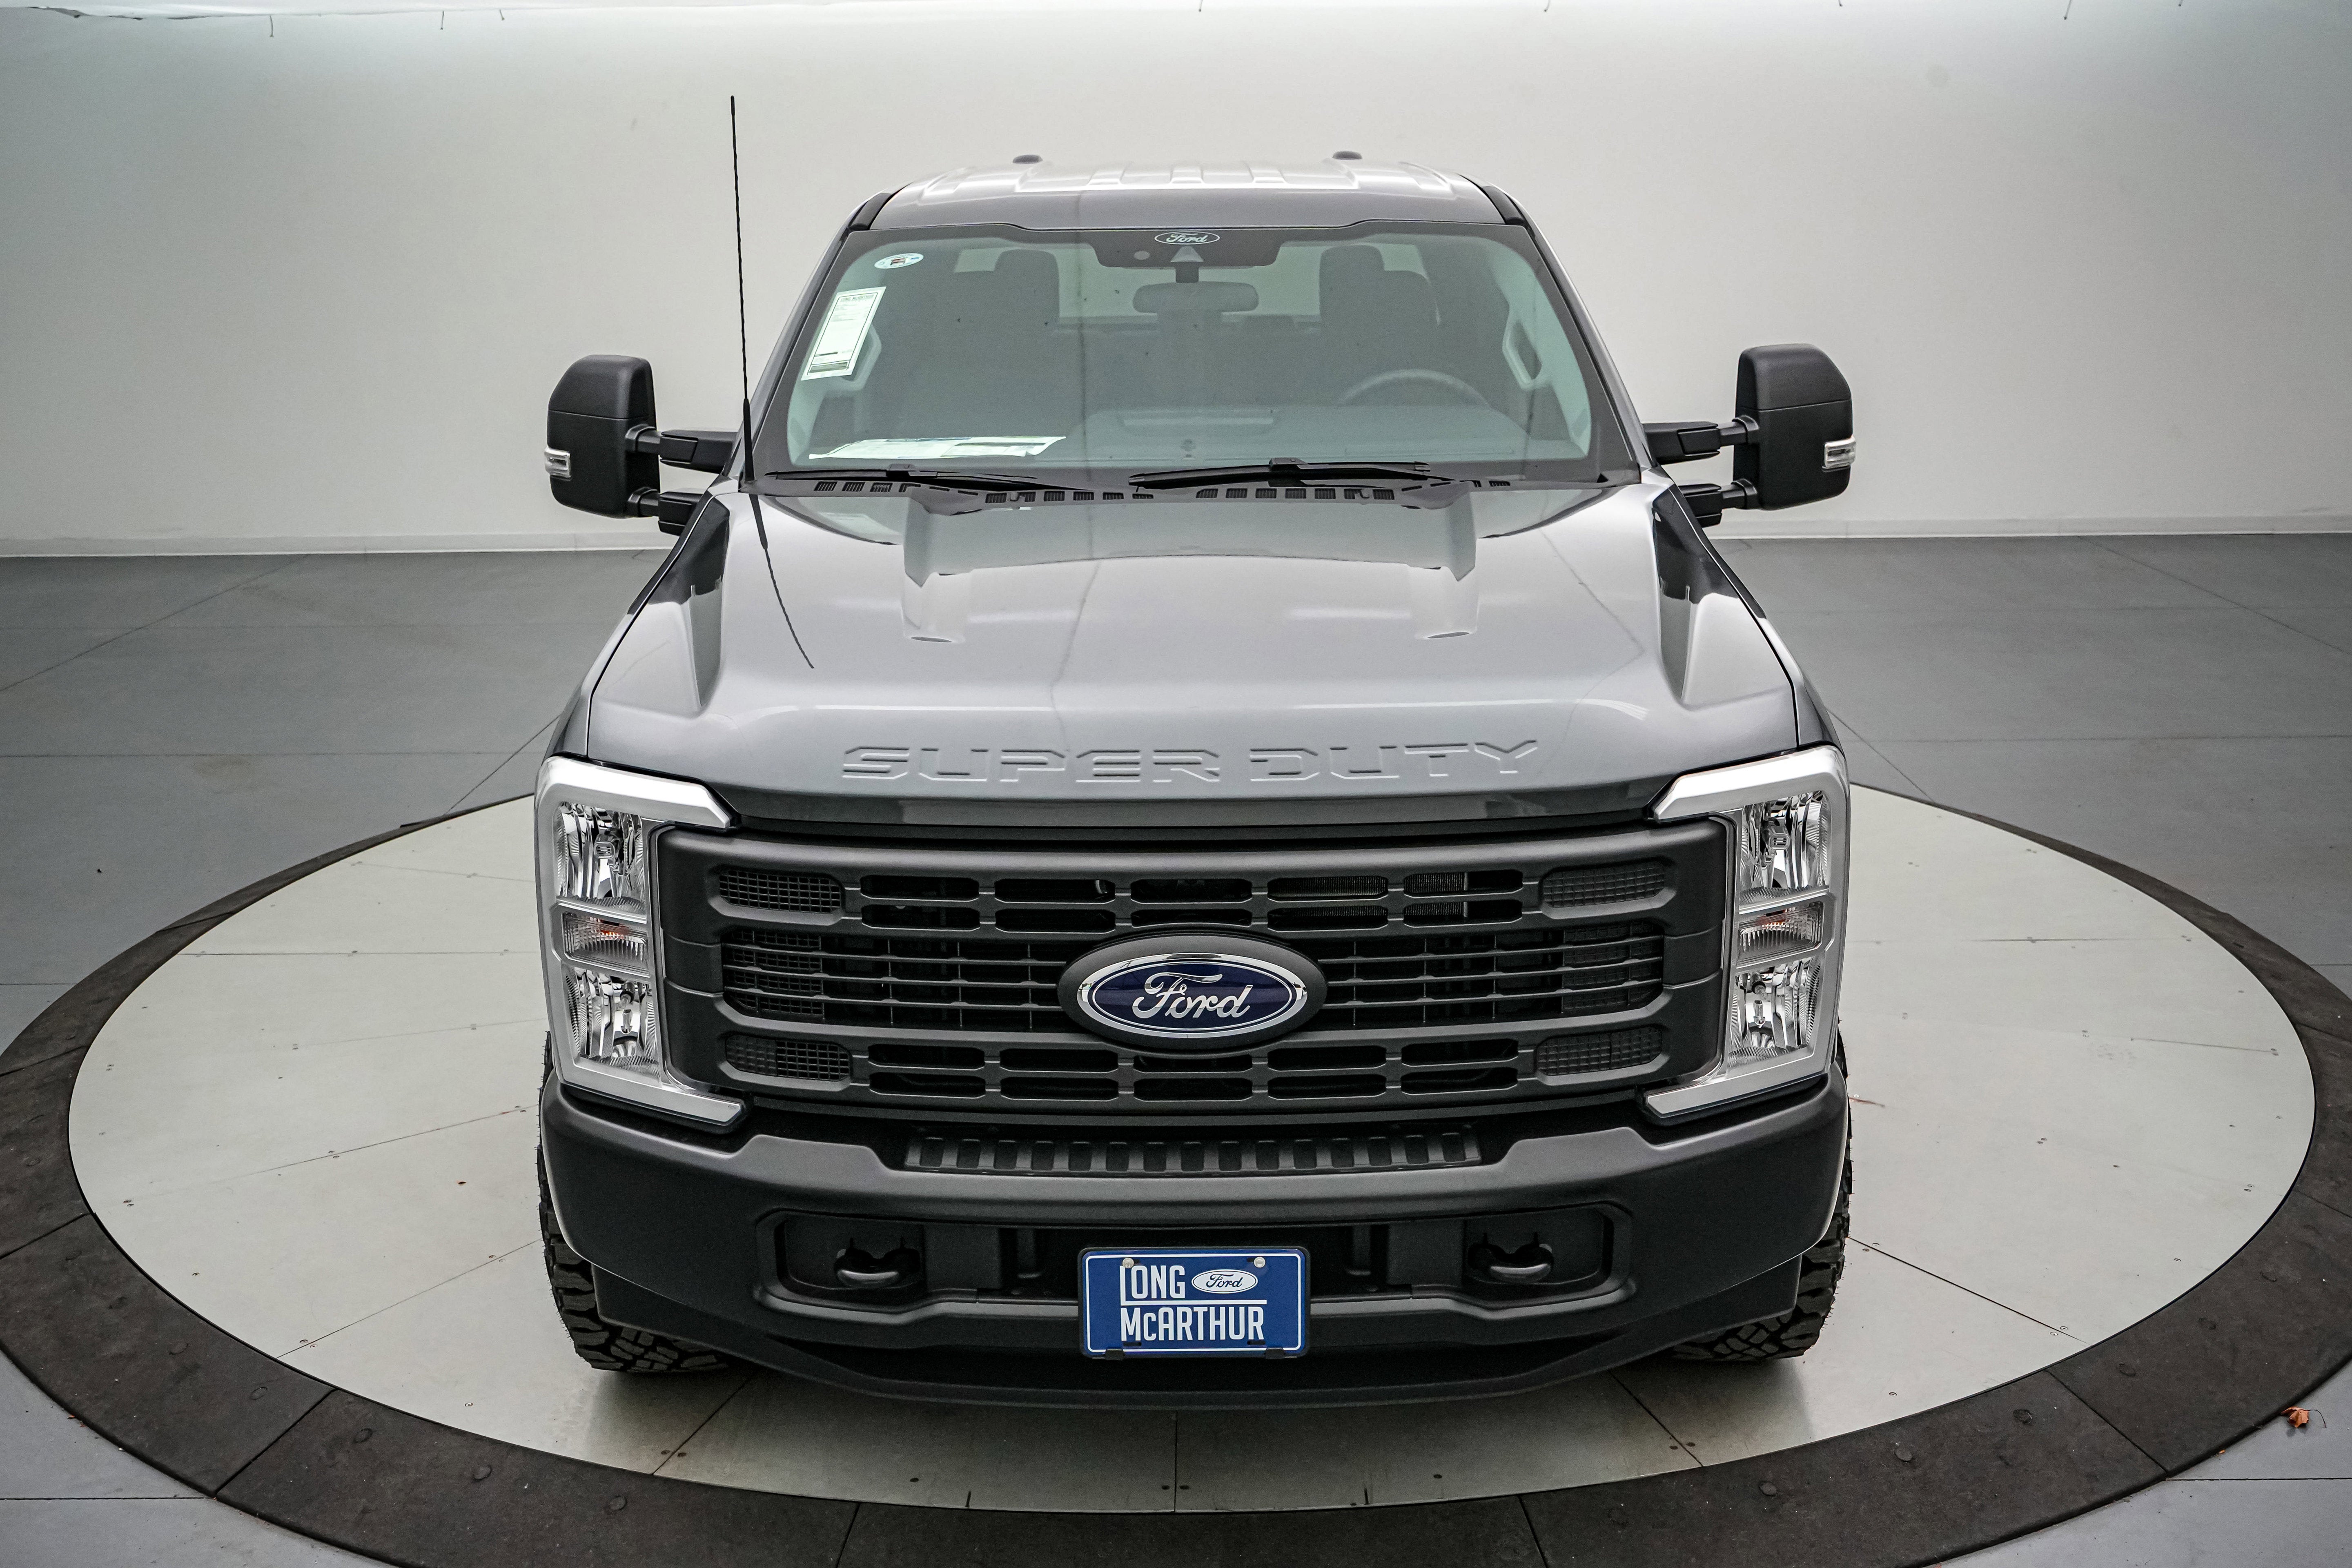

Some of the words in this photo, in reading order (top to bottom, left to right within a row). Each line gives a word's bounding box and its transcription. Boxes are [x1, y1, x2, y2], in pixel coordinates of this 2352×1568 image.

[1166, 233, 1208, 243] Ford
[842, 746, 1221, 783] SUPER
[1250, 739, 1538, 781] DUTY
[1131, 972, 1250, 1018] Ford
[1120, 1265, 1185, 1305] LONG
[1205, 1273, 1243, 1288] Ford
[1121, 1306, 1264, 1341] McARTHUR
